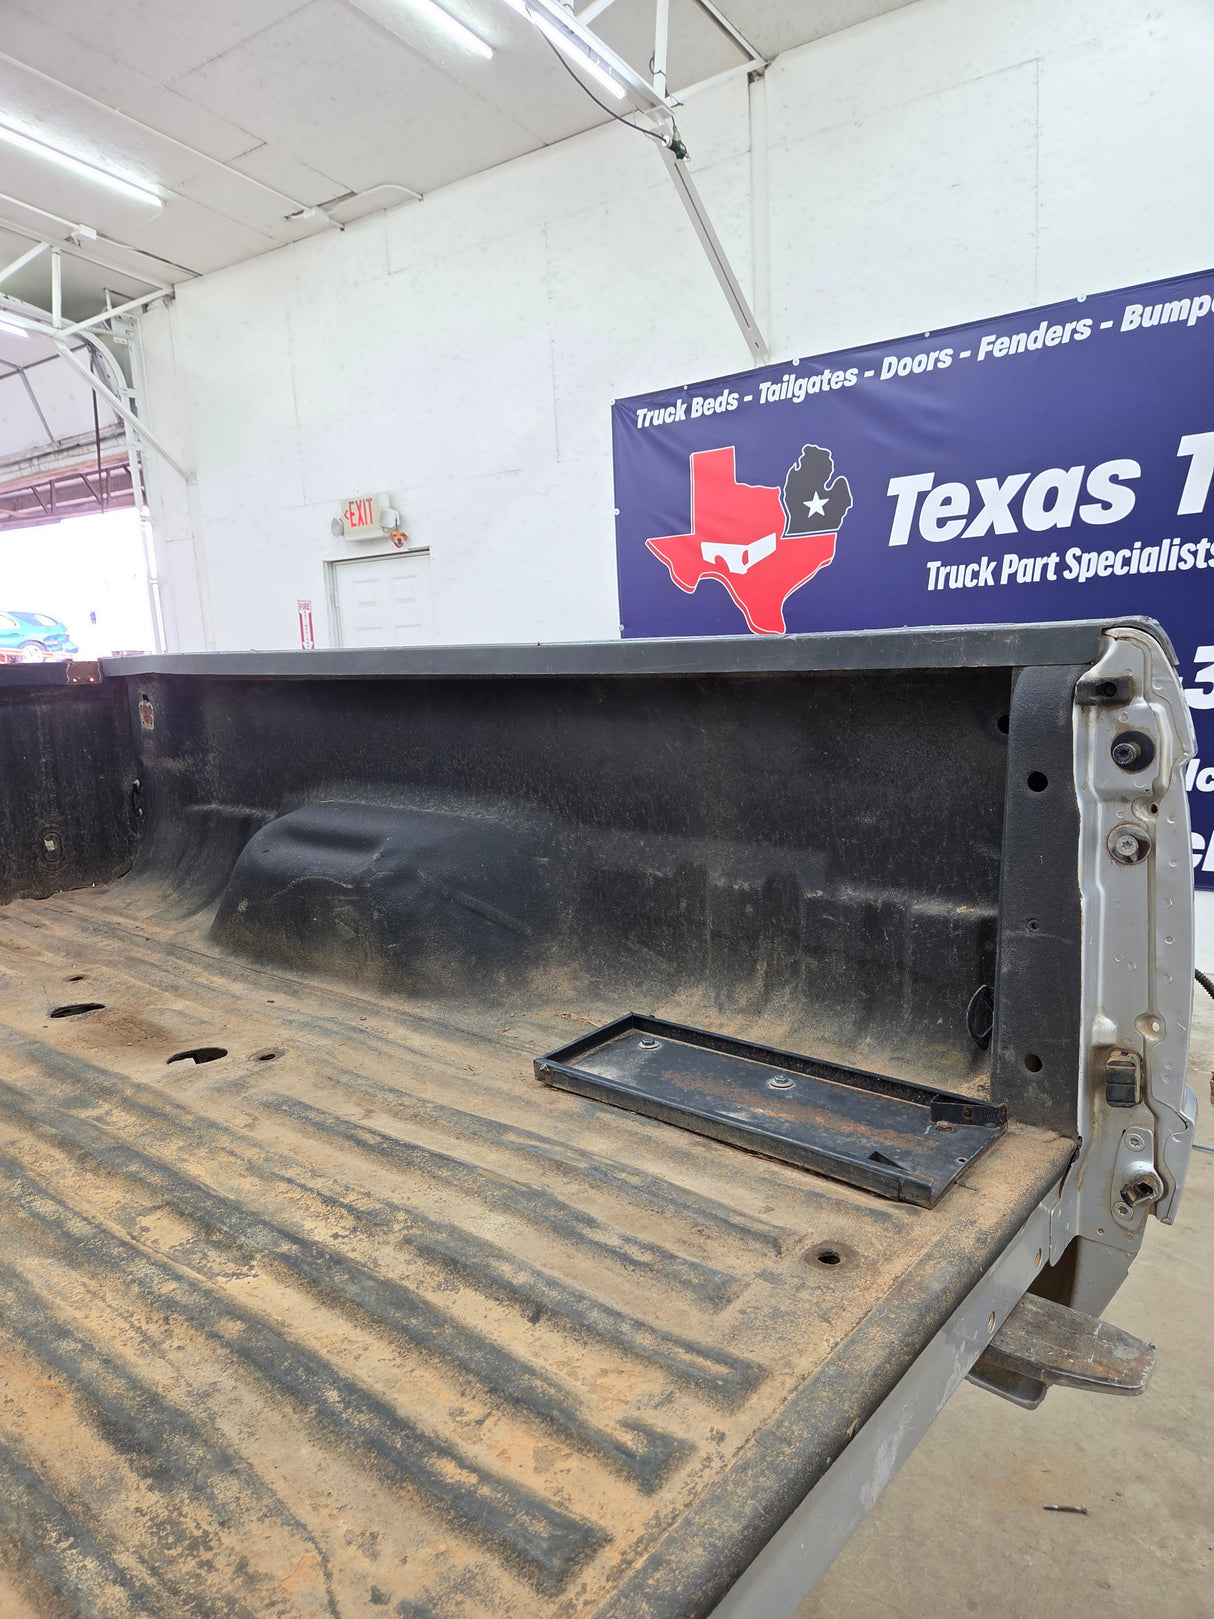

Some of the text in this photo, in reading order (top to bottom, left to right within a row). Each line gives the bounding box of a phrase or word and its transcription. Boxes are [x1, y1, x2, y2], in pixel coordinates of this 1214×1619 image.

[636, 399, 687, 429] Truck
[690, 389, 740, 419] Beds
[758, 367, 859, 404] Tailgates
[879, 348, 954, 381] Doors
[976, 318, 1093, 362] Fenders
[1120, 294, 1214, 333] Bump
[348, 498, 374, 527] EXIT
[886, 458, 1142, 547] Texas
[926, 556, 998, 591] Truck
[1000, 552, 1060, 585] Part
